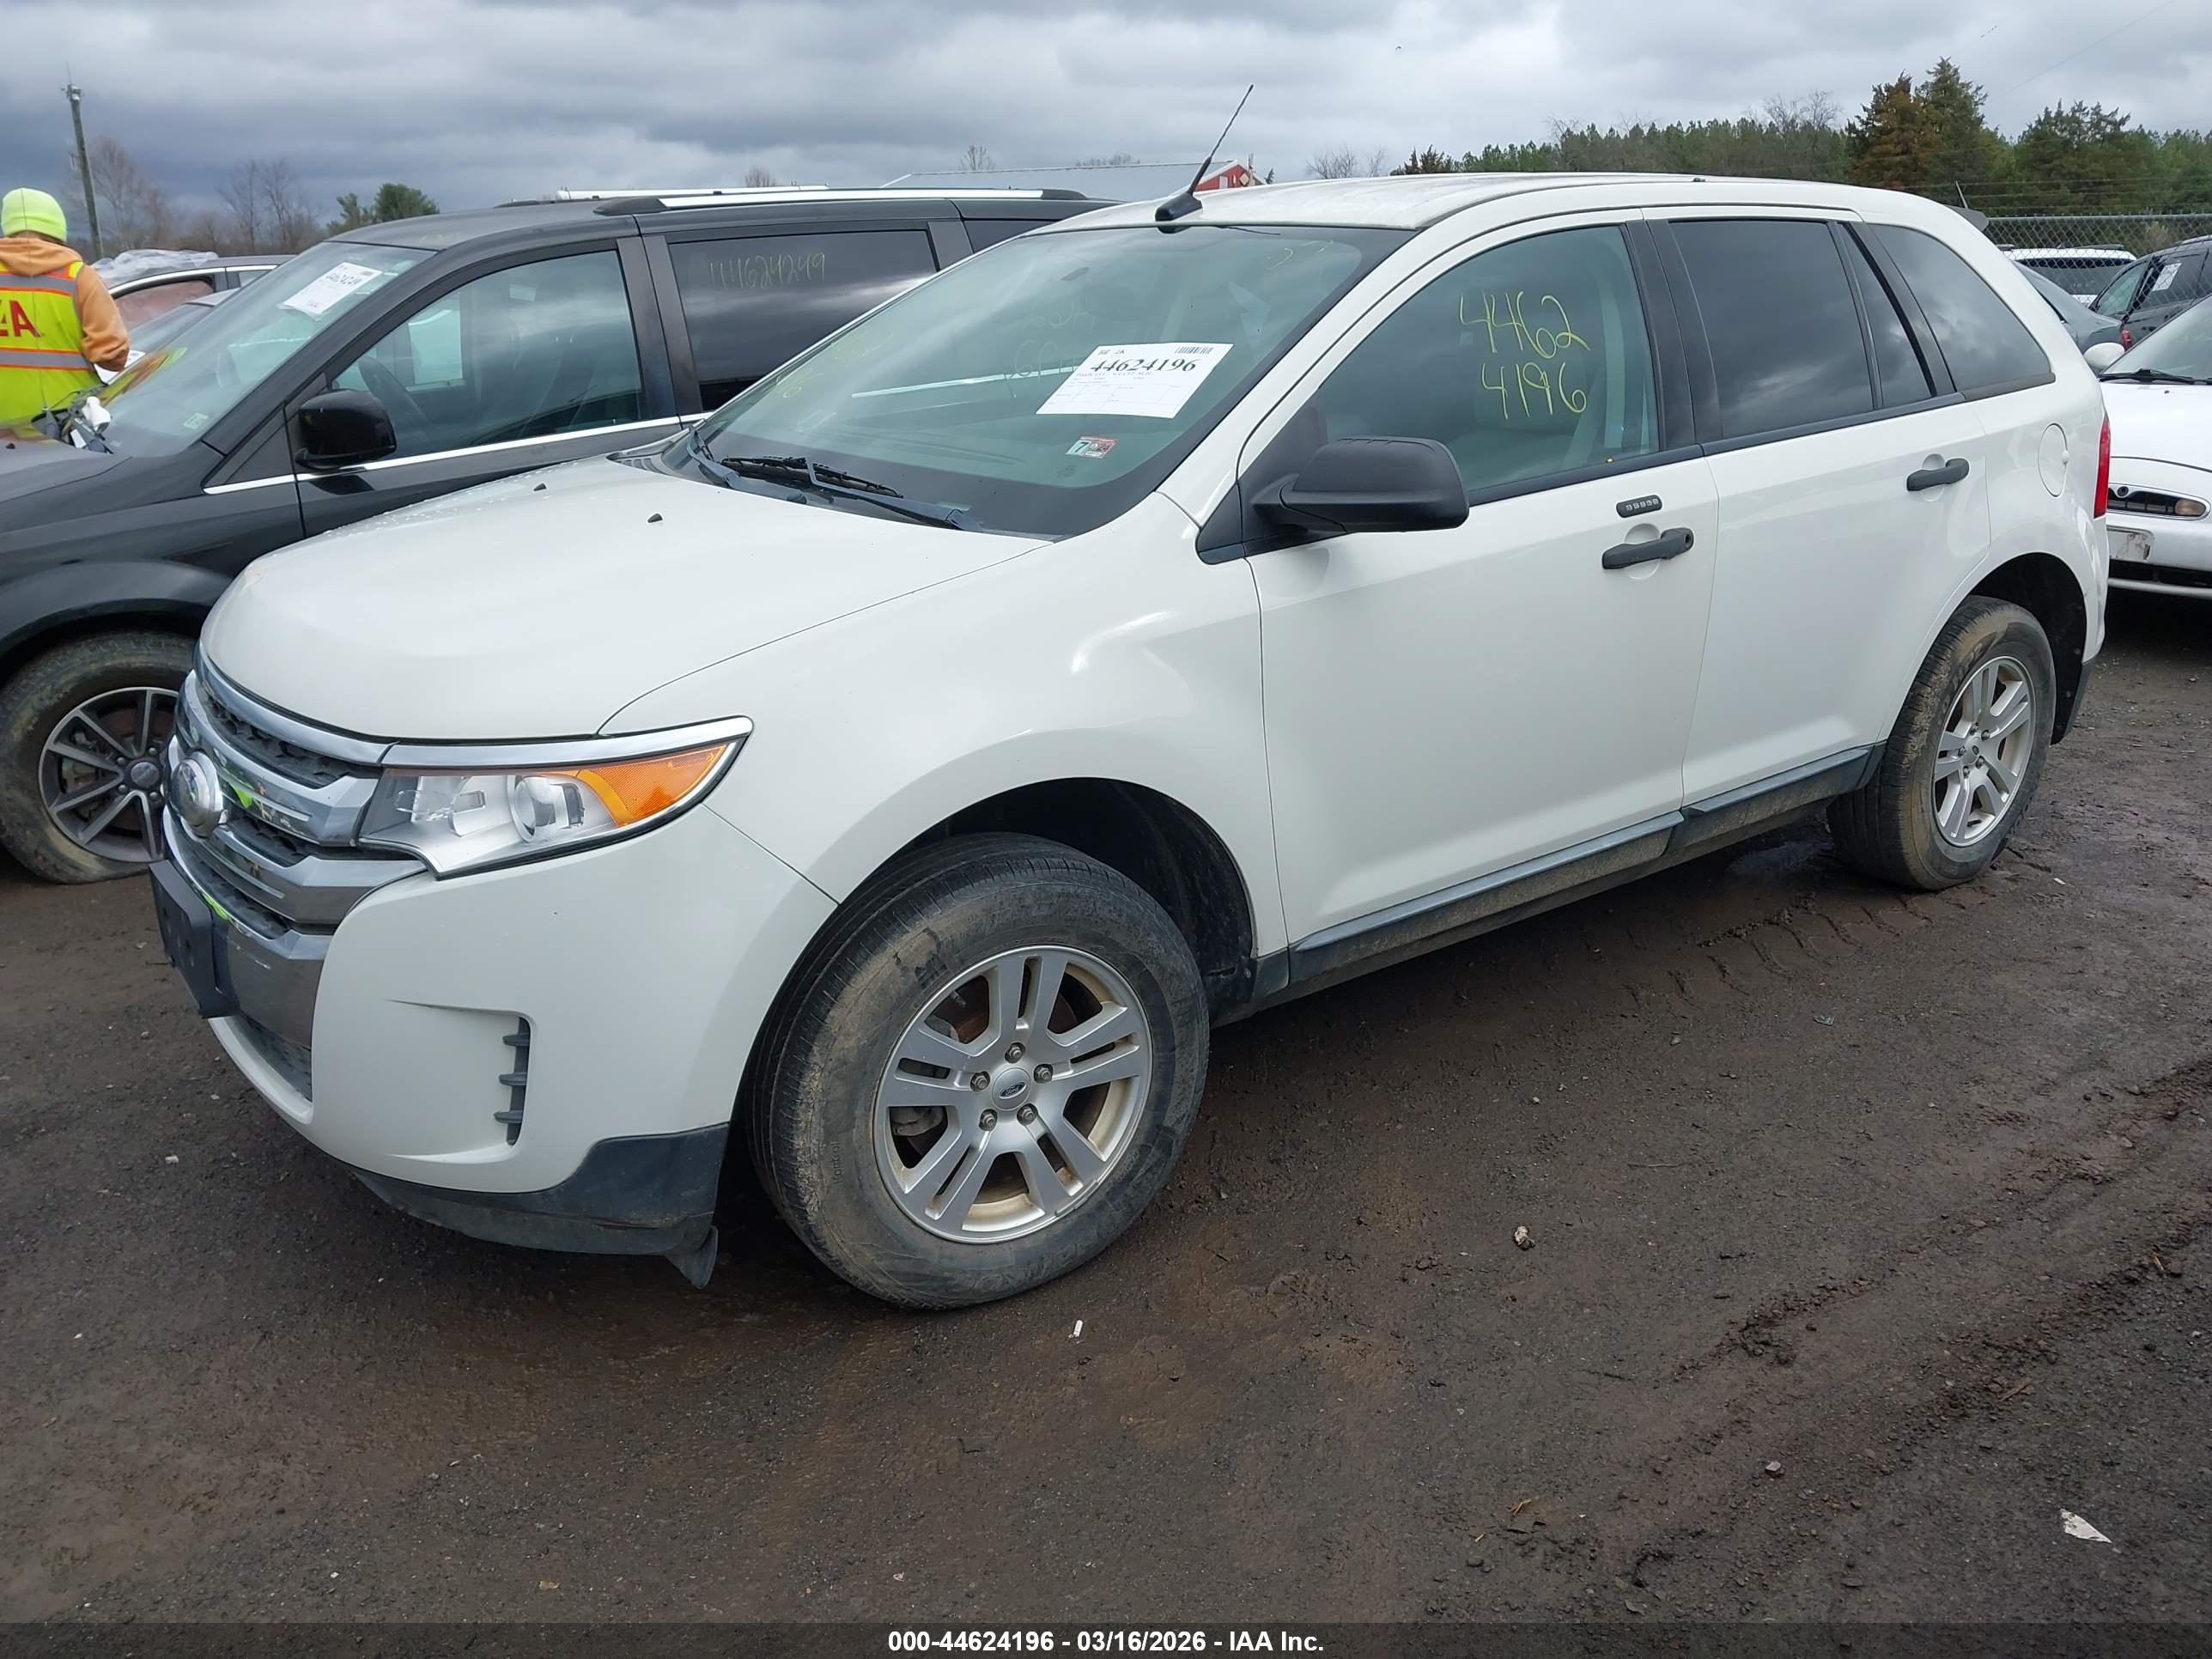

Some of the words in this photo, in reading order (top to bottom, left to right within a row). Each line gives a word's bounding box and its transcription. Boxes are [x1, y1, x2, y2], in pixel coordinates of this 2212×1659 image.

[0, 298, 41, 337] A
[1460, 289, 1589, 359] 4462
[1091, 358, 1200, 372] 44624196
[1481, 362, 1587, 419] 4196
[1074, 441, 1090, 453] 7
